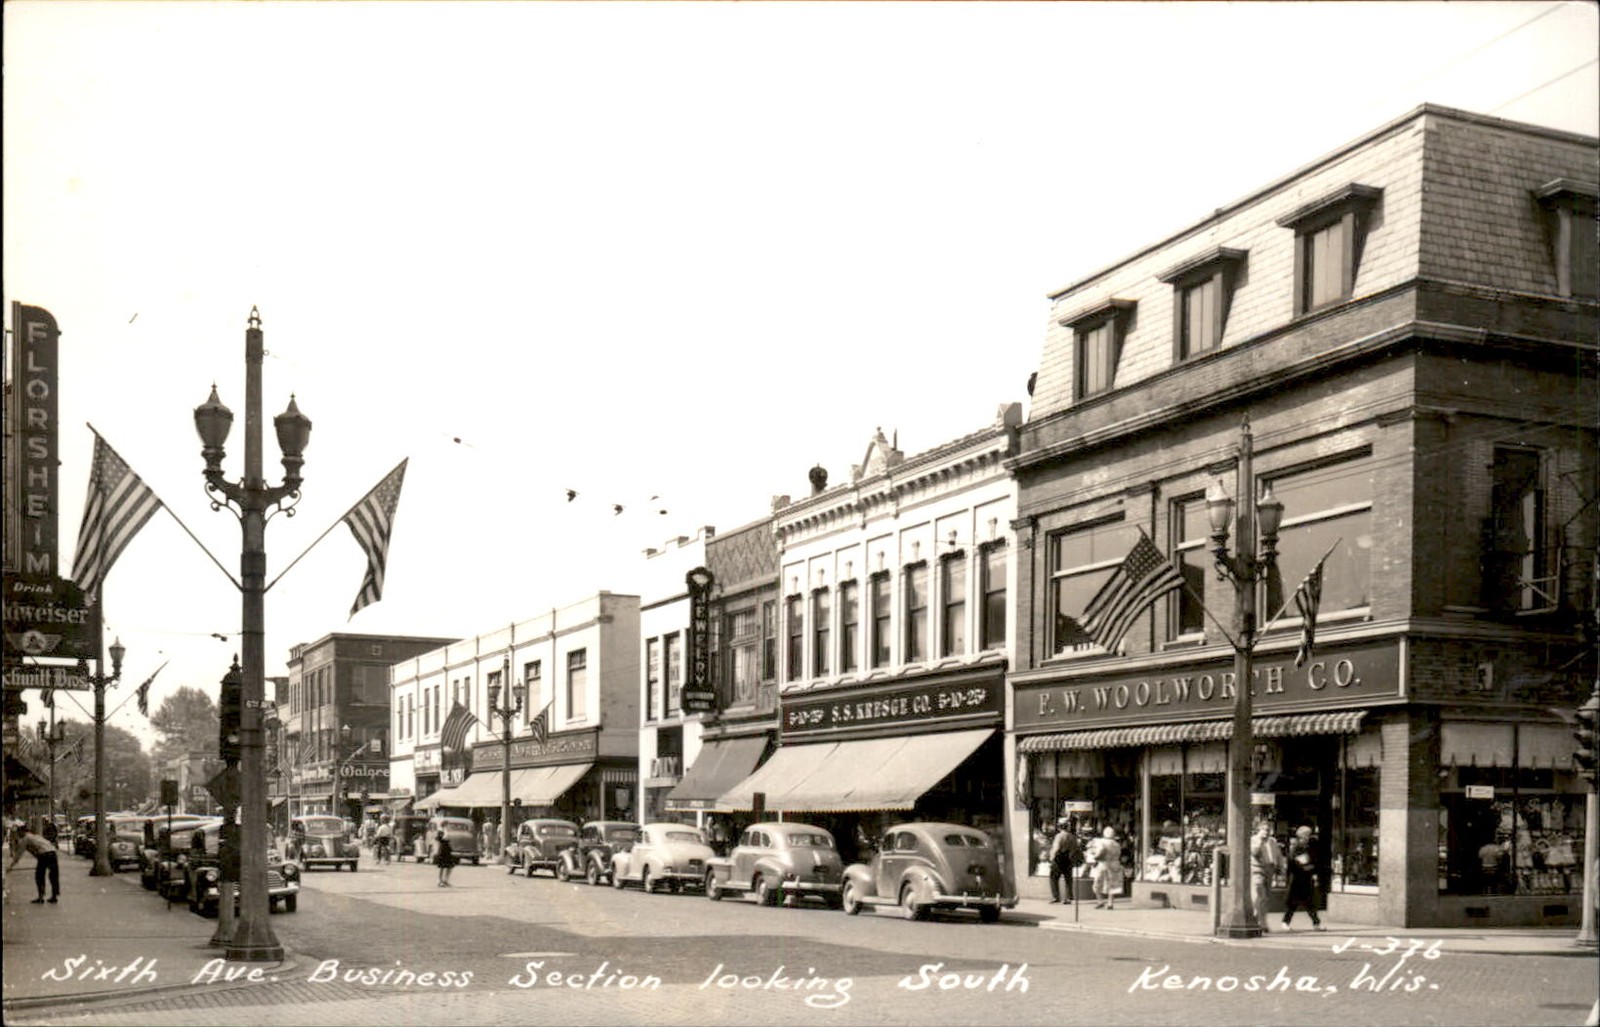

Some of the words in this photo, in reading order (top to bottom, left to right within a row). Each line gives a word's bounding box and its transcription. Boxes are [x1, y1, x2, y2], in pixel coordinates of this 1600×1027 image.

[27, 320, 50, 575] FLORSHEIM
[13, 582, 53, 594] Drink
[4, 601, 89, 624] dweiser
[695, 591, 707, 686] JEWELRY
[856, 696, 908, 720] KRESGE
[912, 693, 932, 714] CO.
[1039, 693, 1056, 717] F.
[1063, 689, 1086, 713] W.
[1091, 665, 1286, 710] WOOLWORH
[1307, 659, 1361, 691] CO.
